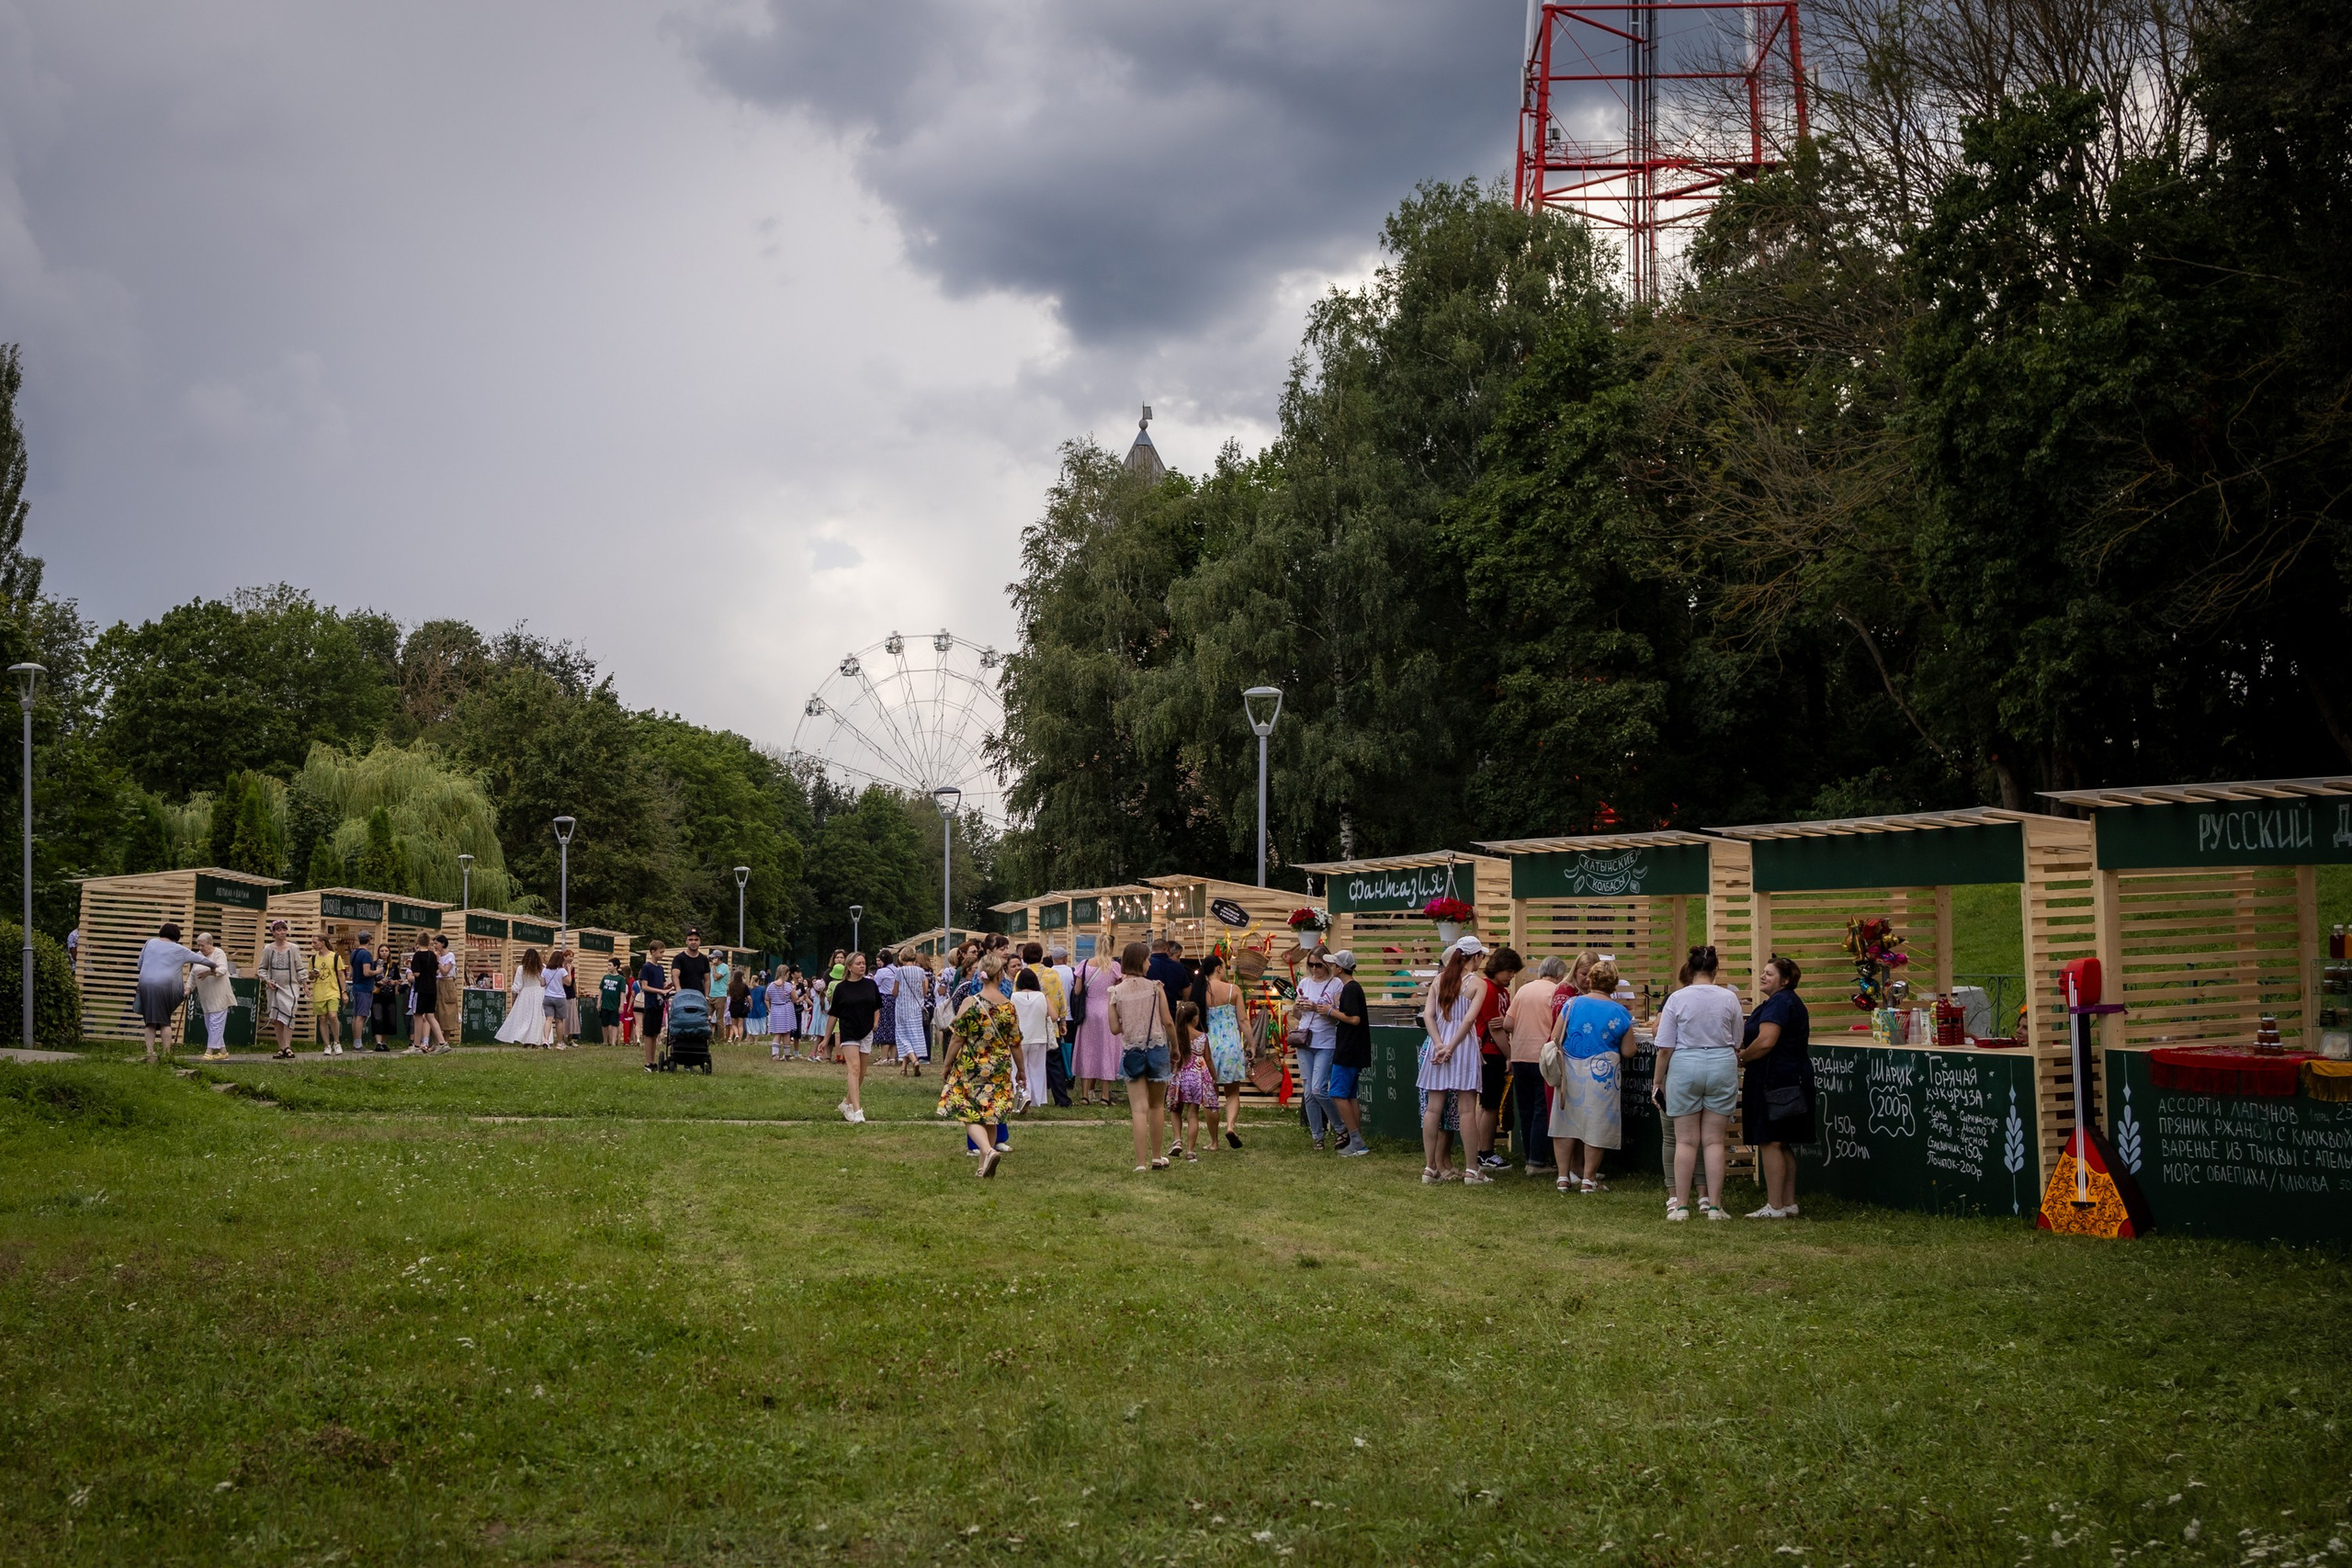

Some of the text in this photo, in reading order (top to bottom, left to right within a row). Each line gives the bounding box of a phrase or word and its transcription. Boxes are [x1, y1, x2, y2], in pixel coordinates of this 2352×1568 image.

[2199, 801, 2313, 852] РУССКИЙ
[1583, 852, 1635, 873] КАТЫНСКИЕ
[1592, 874, 1626, 892] КОЛБАСЫ
[1871, 1057, 1913, 1087] ШАРИК
[1926, 1087, 1984, 1109] КУКУРУЗА
[2158, 1097, 2222, 1117] АССОРТИ
[2159, 1117, 2211, 1137] ПРЯНИК
[2215, 1119, 2273, 1142] РЖАНОЙ
[2292, 1127, 2352, 1149] КЛЮКВОЙ
[2162, 1138, 2220, 1160] ВАРЕНЬЕ
[2226, 1141, 2243, 1161] ИЗ
[2246, 1143, 2297, 1167] ТЫКВЫ
[2315, 1149, 2352, 1169] АПЕЛЬ
[2163, 1163, 2201, 1185] МОРС
